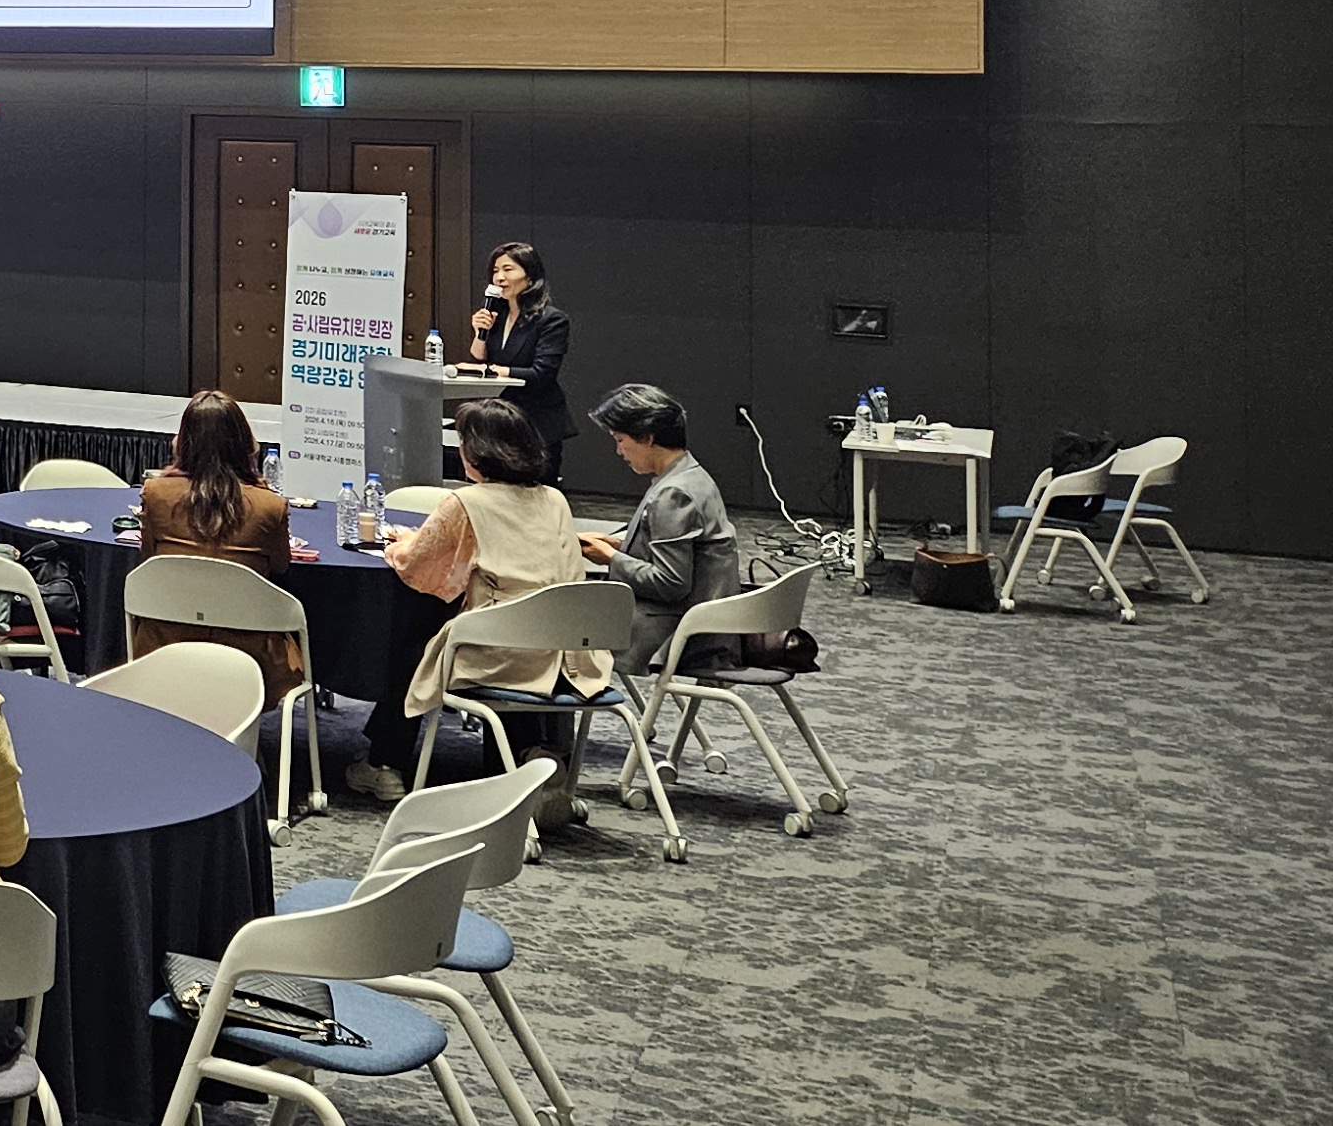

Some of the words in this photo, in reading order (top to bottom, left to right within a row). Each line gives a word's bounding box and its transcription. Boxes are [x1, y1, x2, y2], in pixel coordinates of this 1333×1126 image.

[295, 290, 327, 306] 2026
[292, 313, 366, 338] 공·사립유치원
[369, 319, 393, 340] 원장
[291, 364, 353, 388] 역량강화
